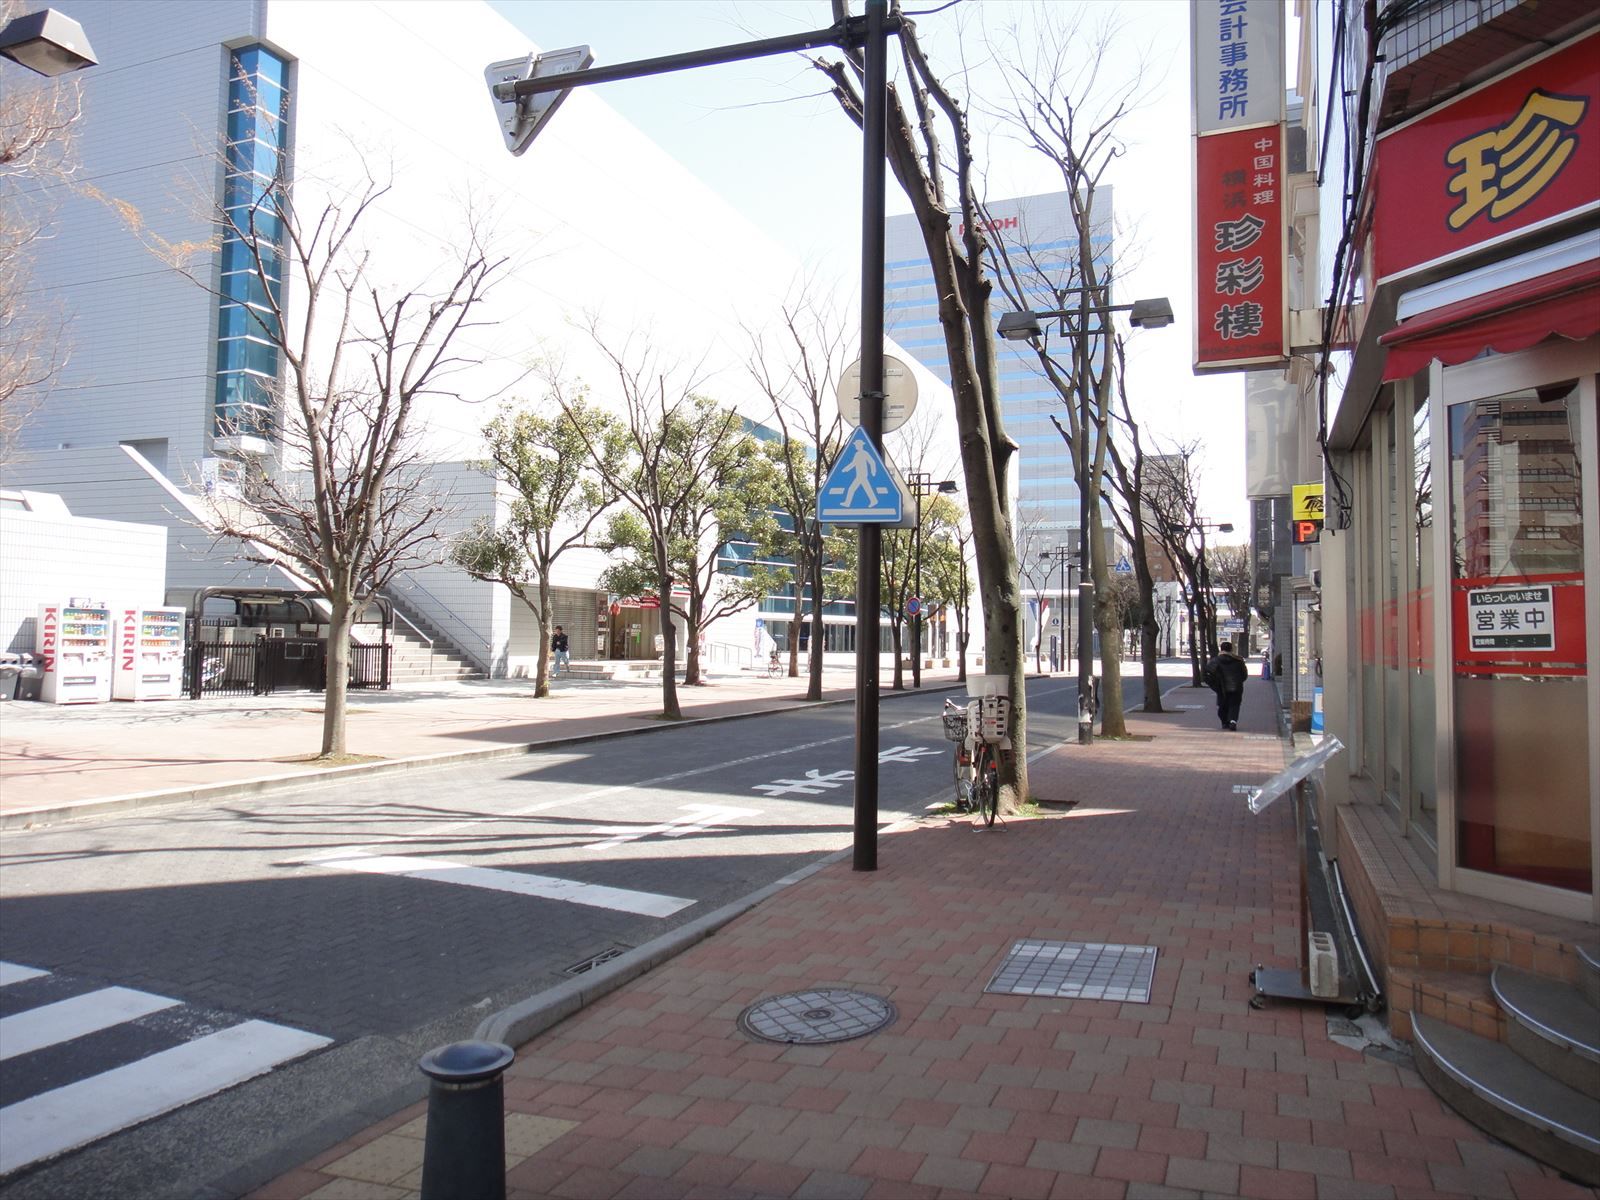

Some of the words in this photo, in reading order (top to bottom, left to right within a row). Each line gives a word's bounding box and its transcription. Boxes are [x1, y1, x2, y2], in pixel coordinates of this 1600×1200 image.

[1252, 137, 1275, 206] 中国料理
[1445, 87, 1591, 233] 珍
[1475, 591, 1543, 604] いらっしゃいませ
[1475, 607, 1546, 631] 営業中
[43, 607, 58, 673] KIRIN
[122, 609, 137, 671] KIRIN
